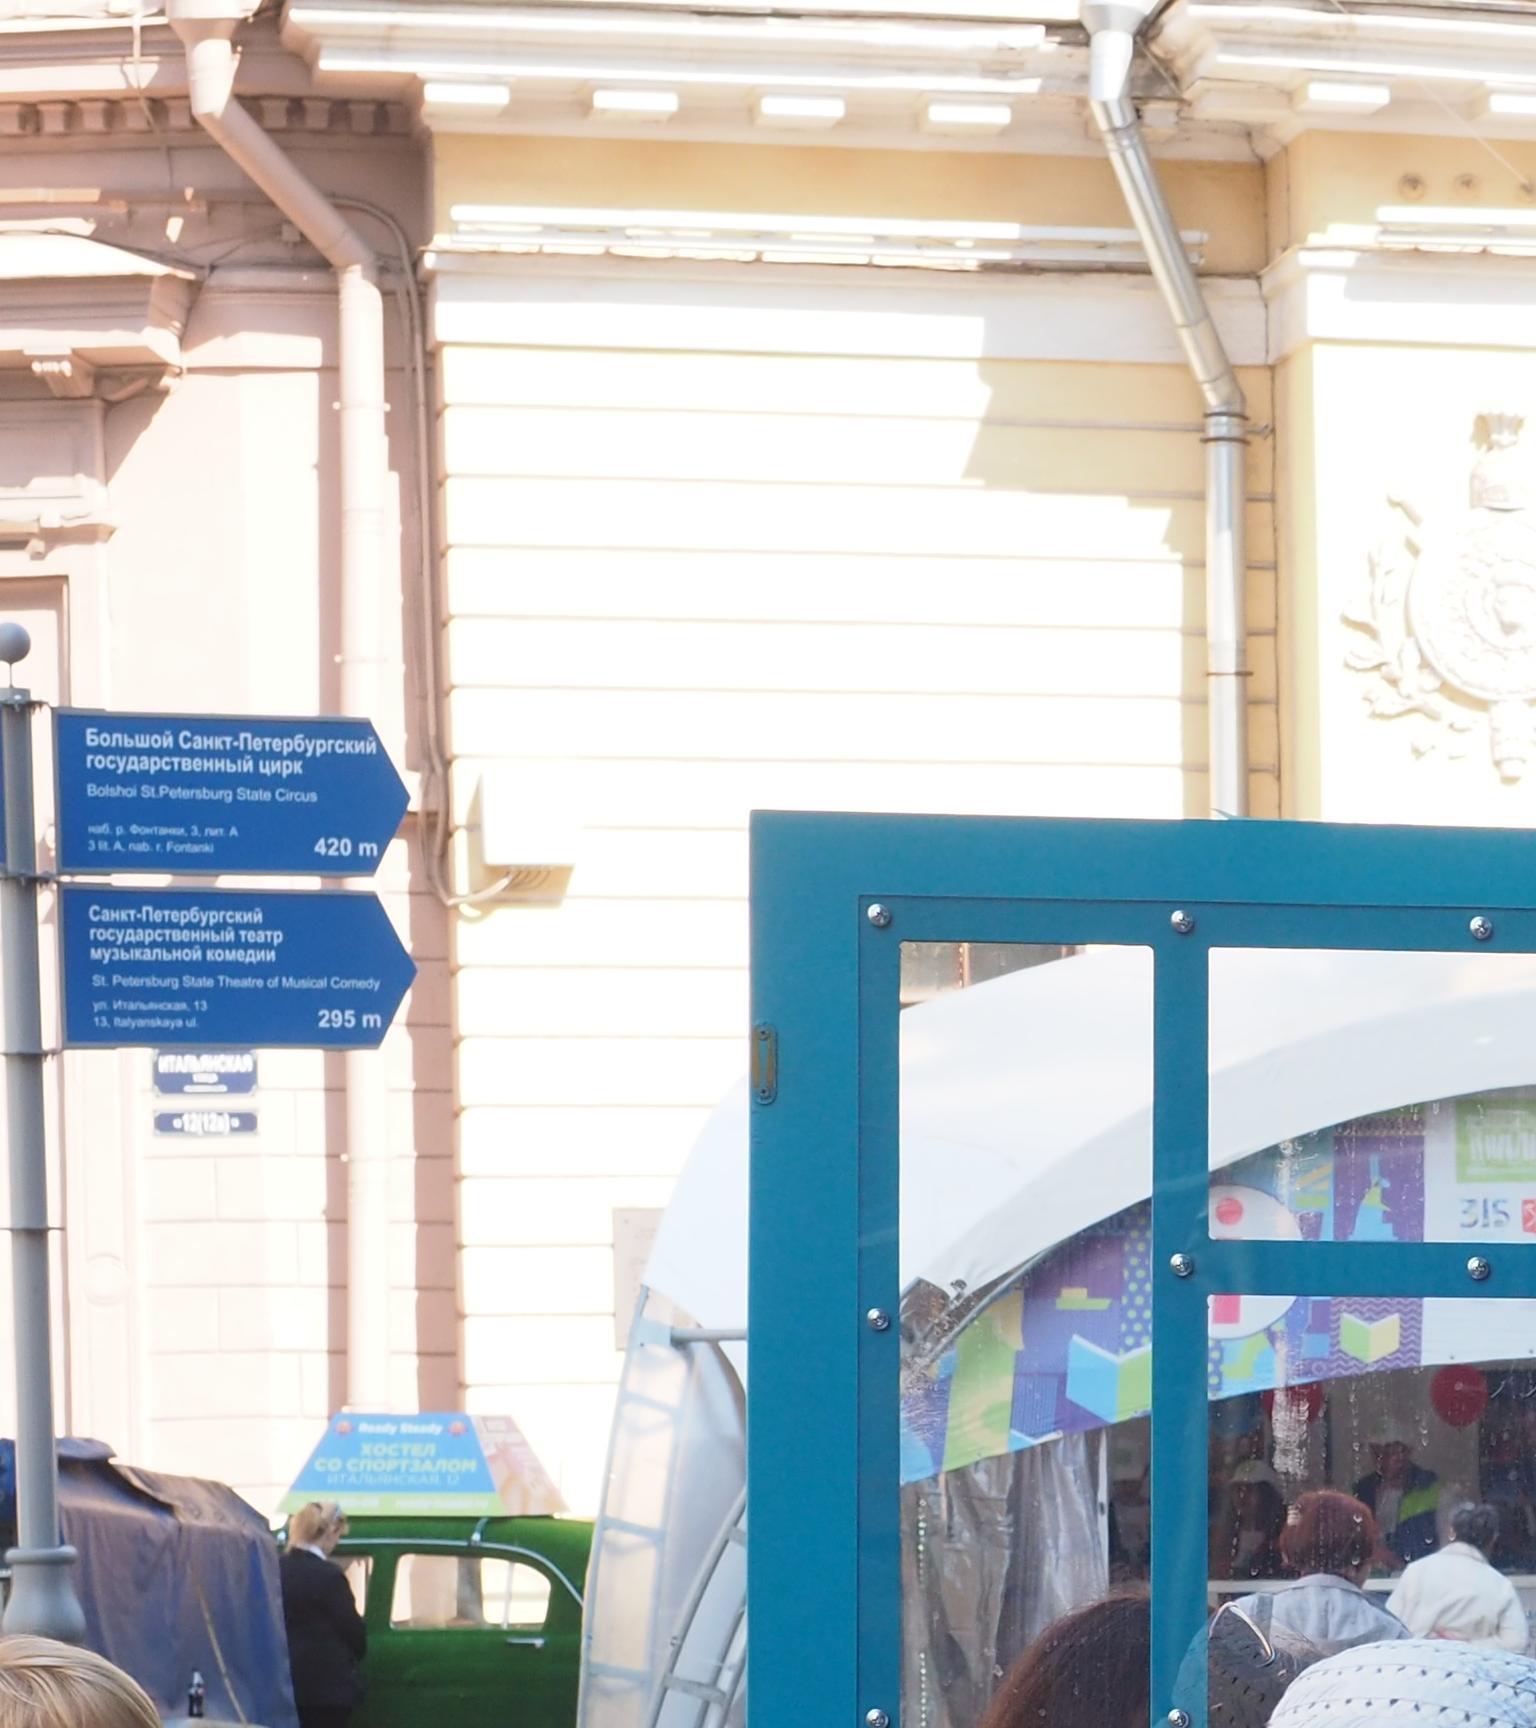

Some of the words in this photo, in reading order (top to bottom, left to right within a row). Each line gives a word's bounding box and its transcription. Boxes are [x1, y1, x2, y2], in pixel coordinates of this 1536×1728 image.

[85, 728, 174, 749] Большой
[178, 730, 377, 758] Санкт-Петербургский
[86, 754, 254, 775] государственный
[258, 759, 304, 779] цирк
[87, 783, 138, 798] Bolshoi
[236, 787, 272, 801] State
[275, 788, 318, 803] Circus
[166, 841, 214, 854] Fontanki
[314, 837, 352, 857] 420
[358, 841, 378, 857] m
[88, 904, 263, 927] Санкт-Петербургский
[89, 926, 235, 945] государственный
[239, 929, 284, 947] театр
[90, 945, 202, 964] музыкальной
[206, 948, 276, 964] комедии
[112, 975, 179, 990] Petersburg
[182, 975, 214, 988] State
[217, 975, 264, 989] Theatre
[267, 976, 280, 989] of
[282, 976, 327, 990] Musical
[330, 976, 380, 992] Comedy
[194, 1001, 208, 1012] 13
[114, 1016, 183, 1030] Italyanskaya
[318, 1009, 356, 1028] 295
[362, 1013, 382, 1028] m
[361, 1442, 437, 1457] ХОСТЕЛ
[315, 1458, 342, 1472] СО
[346, 1458, 477, 1472] СПОРТЗАЛОМ
